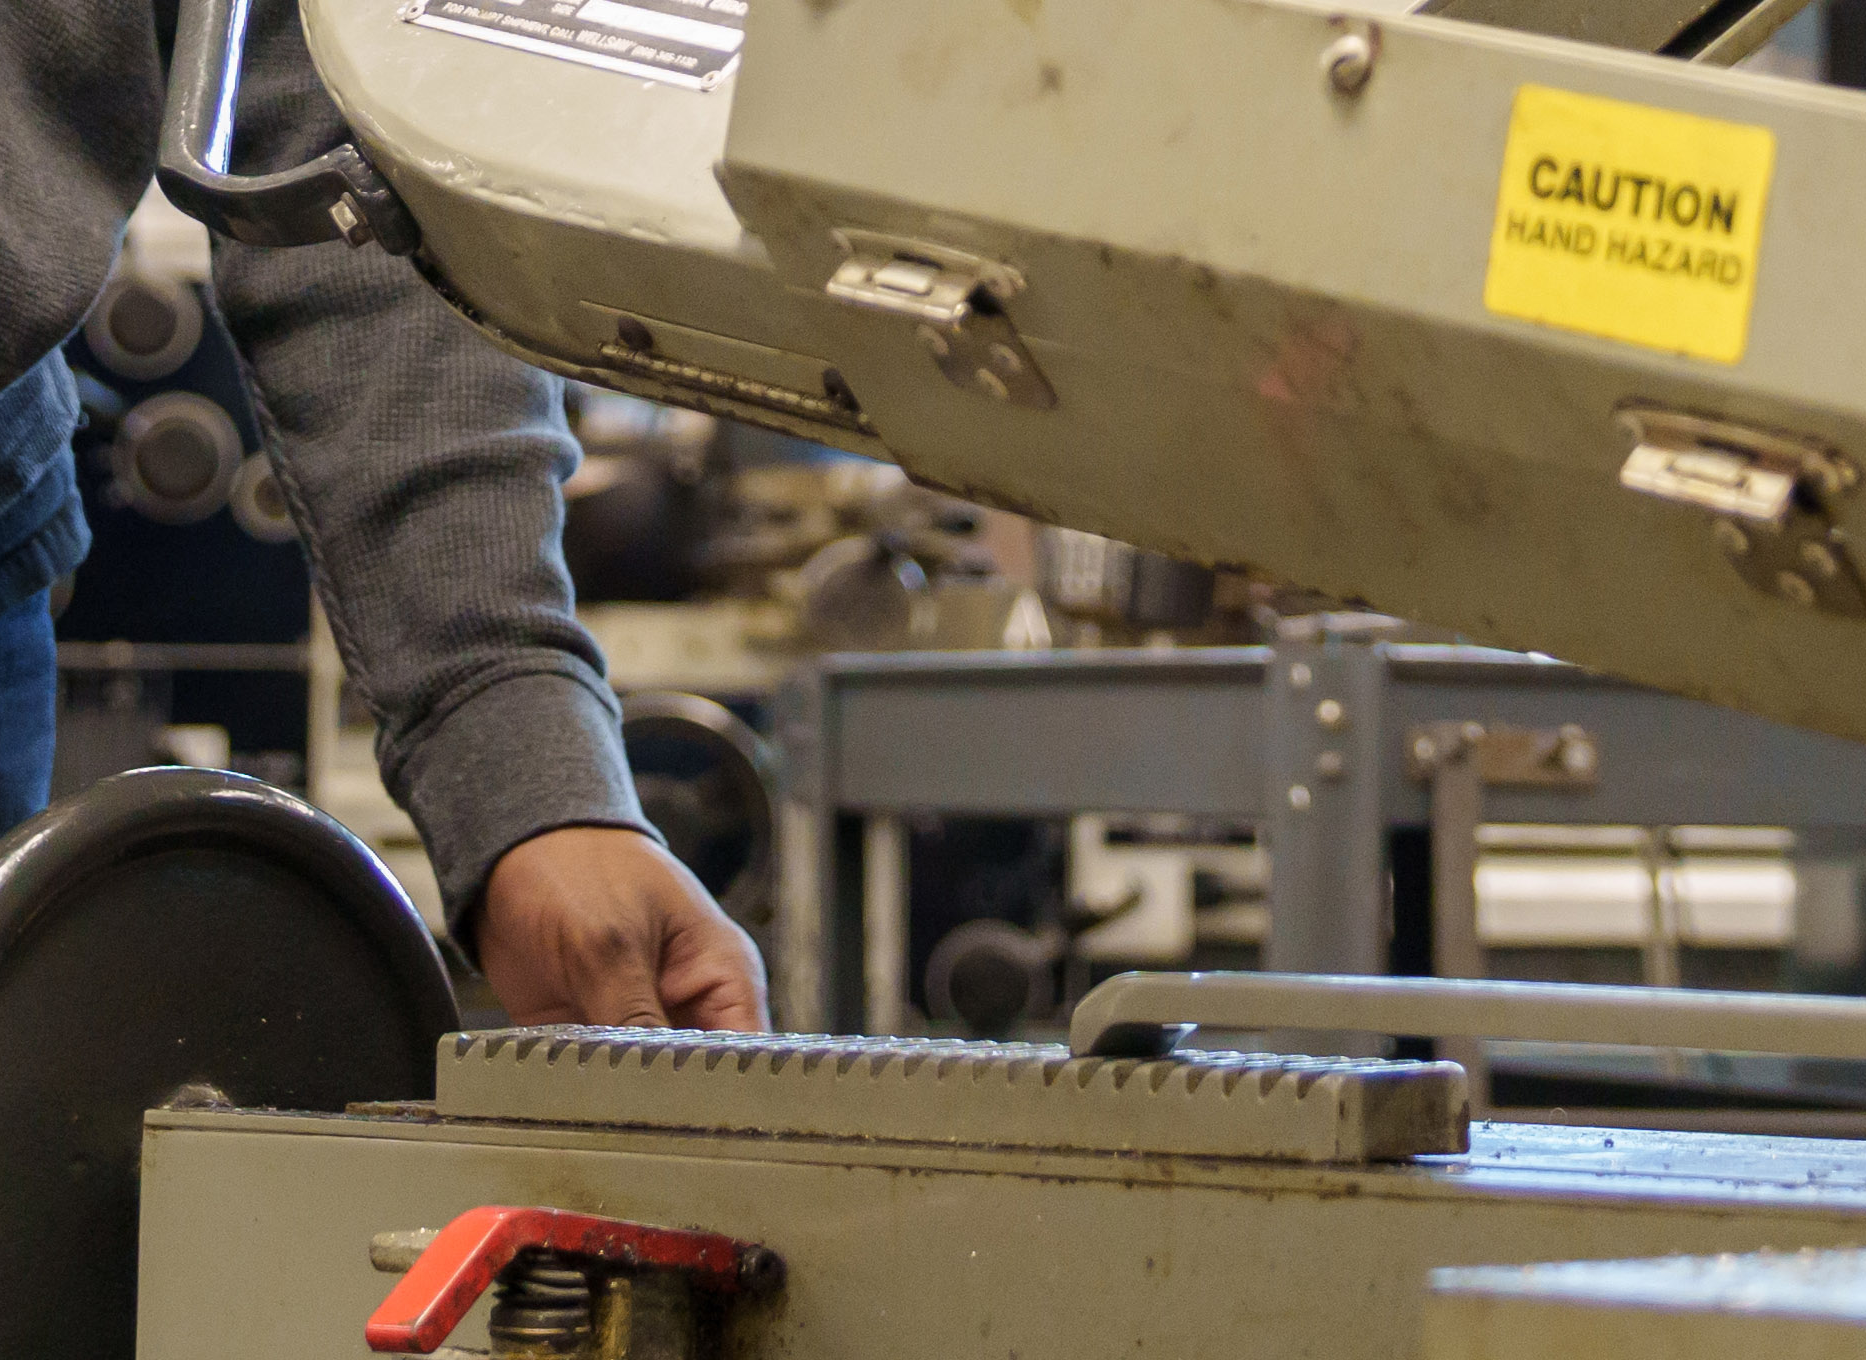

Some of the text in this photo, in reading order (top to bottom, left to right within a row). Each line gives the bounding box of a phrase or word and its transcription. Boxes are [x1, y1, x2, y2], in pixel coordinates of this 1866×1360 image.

[442, 1, 465, 16] FOR
[548, 25, 577, 40] CALL
[550, 2, 577, 17] SIZE
[1528, 155, 1739, 236] CAUTION
[1504, 209, 1745, 287] HAND HAZARD
